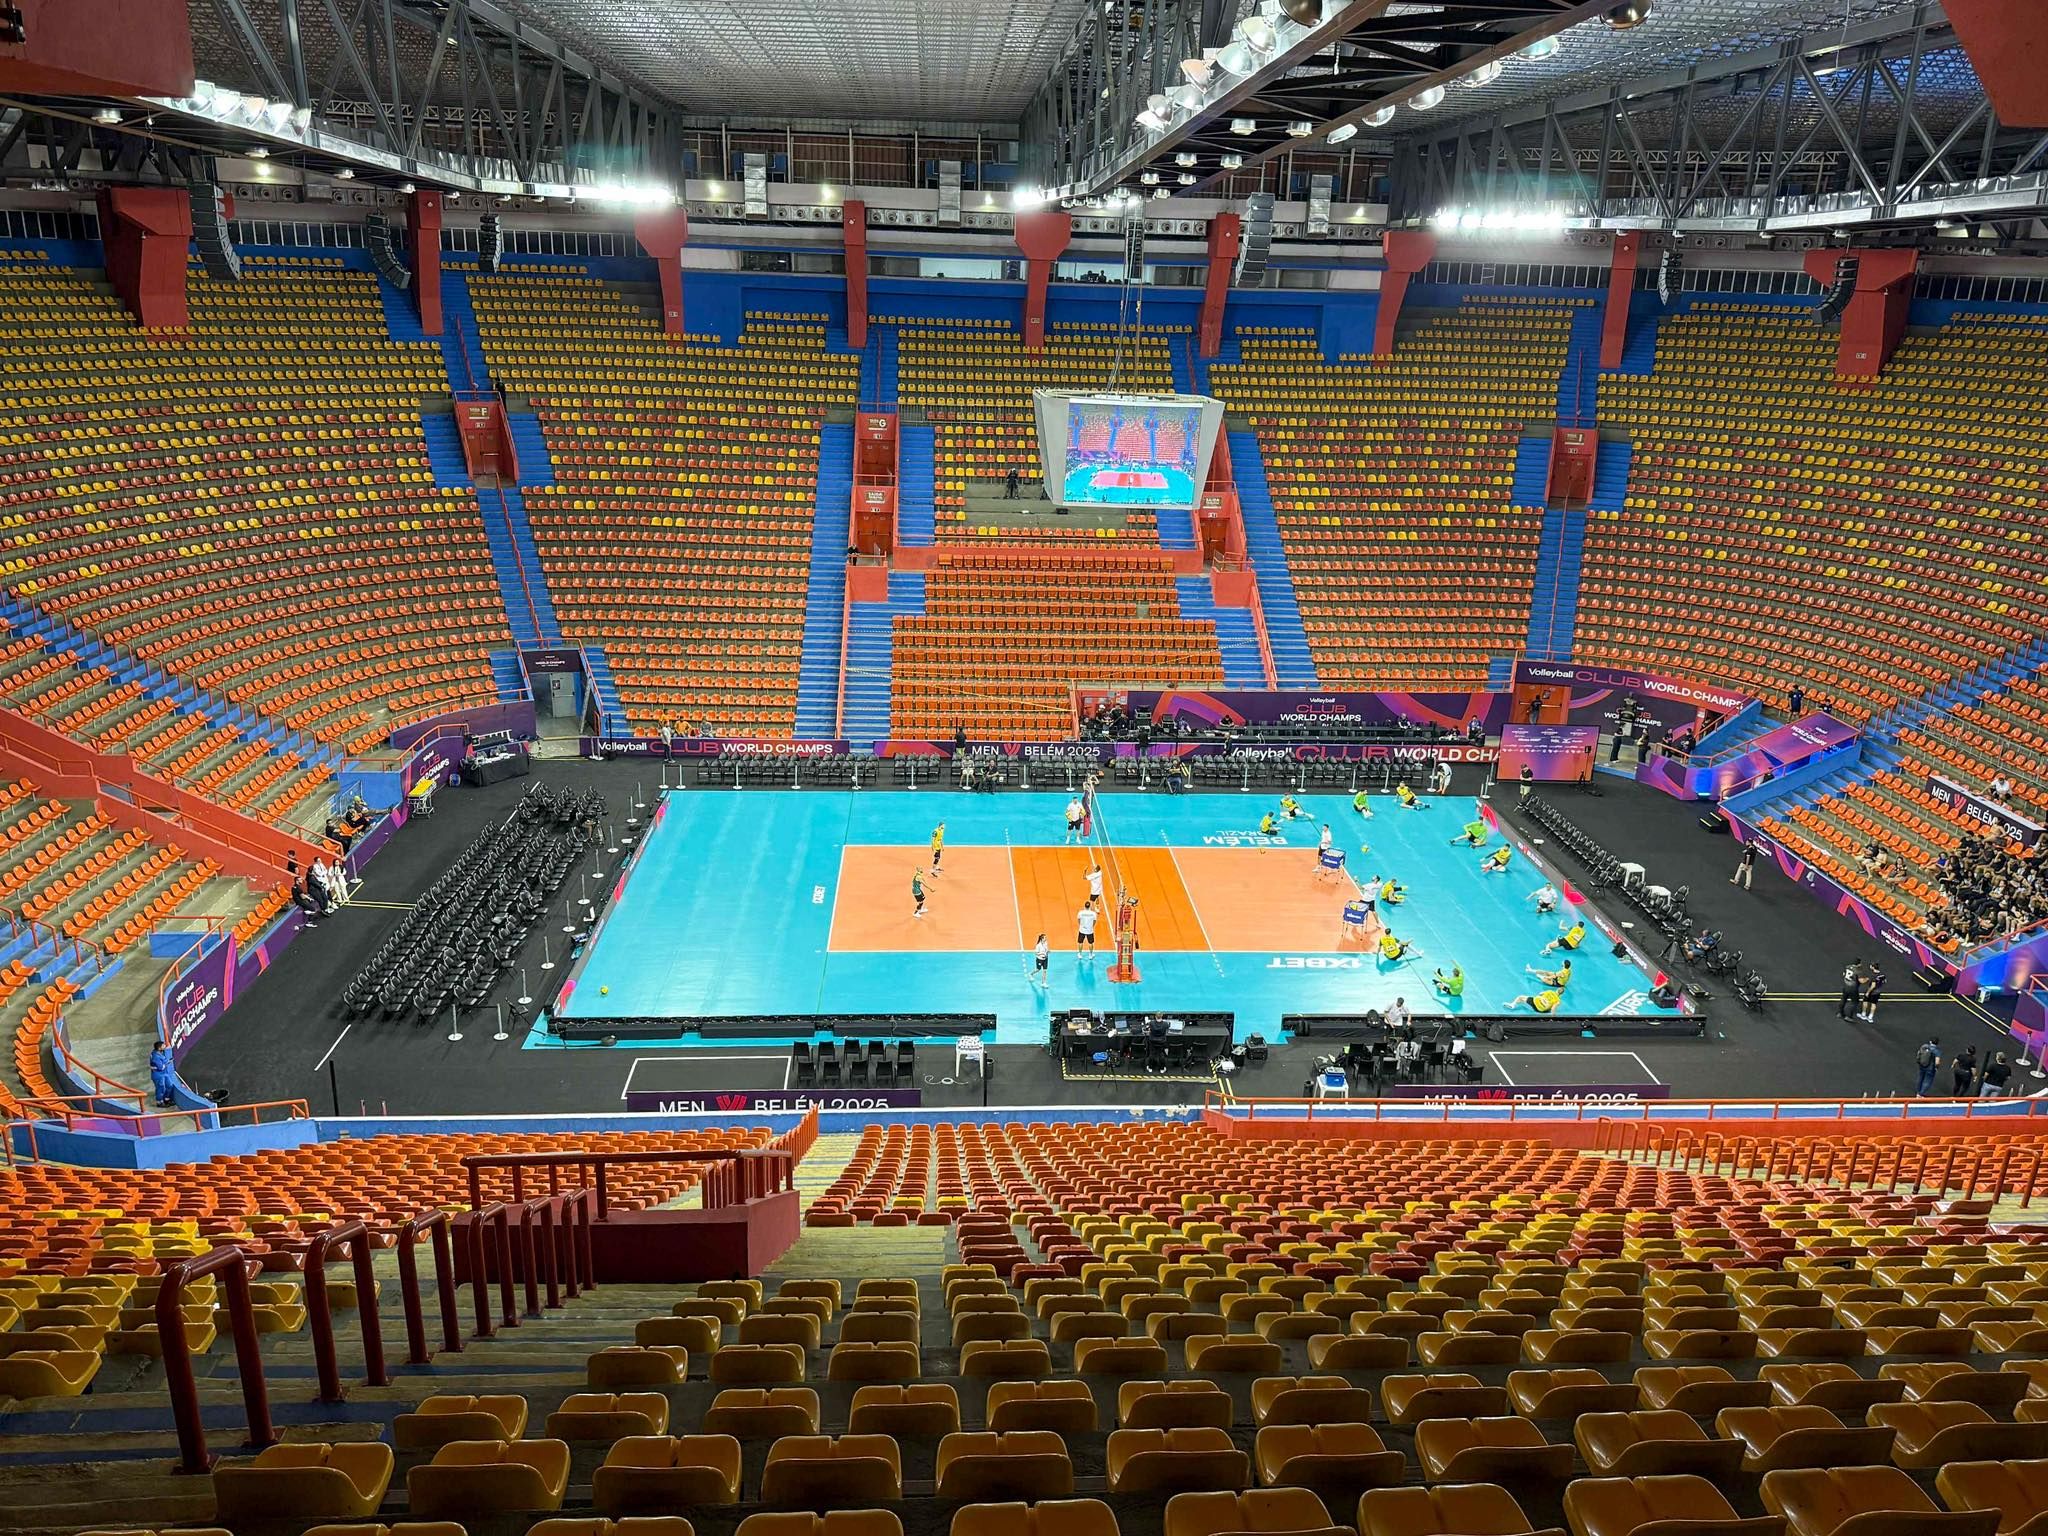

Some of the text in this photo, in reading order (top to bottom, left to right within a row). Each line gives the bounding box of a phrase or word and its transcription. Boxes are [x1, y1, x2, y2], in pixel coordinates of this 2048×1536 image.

[1528, 667, 1744, 710] Volleyball CLUB WORLD CHAMPS
[1296, 704, 1347, 713] CLUB
[1319, 714, 1362, 722] CHAMPS
[598, 742, 647, 754] Volleyball
[722, 743, 774, 753] WORLD
[775, 743, 833, 754] CHAMPS
[972, 743, 1100, 756] MEN BELÉM 2025
[1295, 746, 1389, 761] CLUB
[1394, 748, 1462, 761] WORLD
[1931, 786, 1951, 803] MEN
[2003, 823, 2023, 841] 025
[1202, 836, 1288, 847] BELÉM
[172, 984, 206, 1027] CLUB
[187, 987, 218, 1022] CHAMPS
[659, 1101, 706, 1112] MEN
